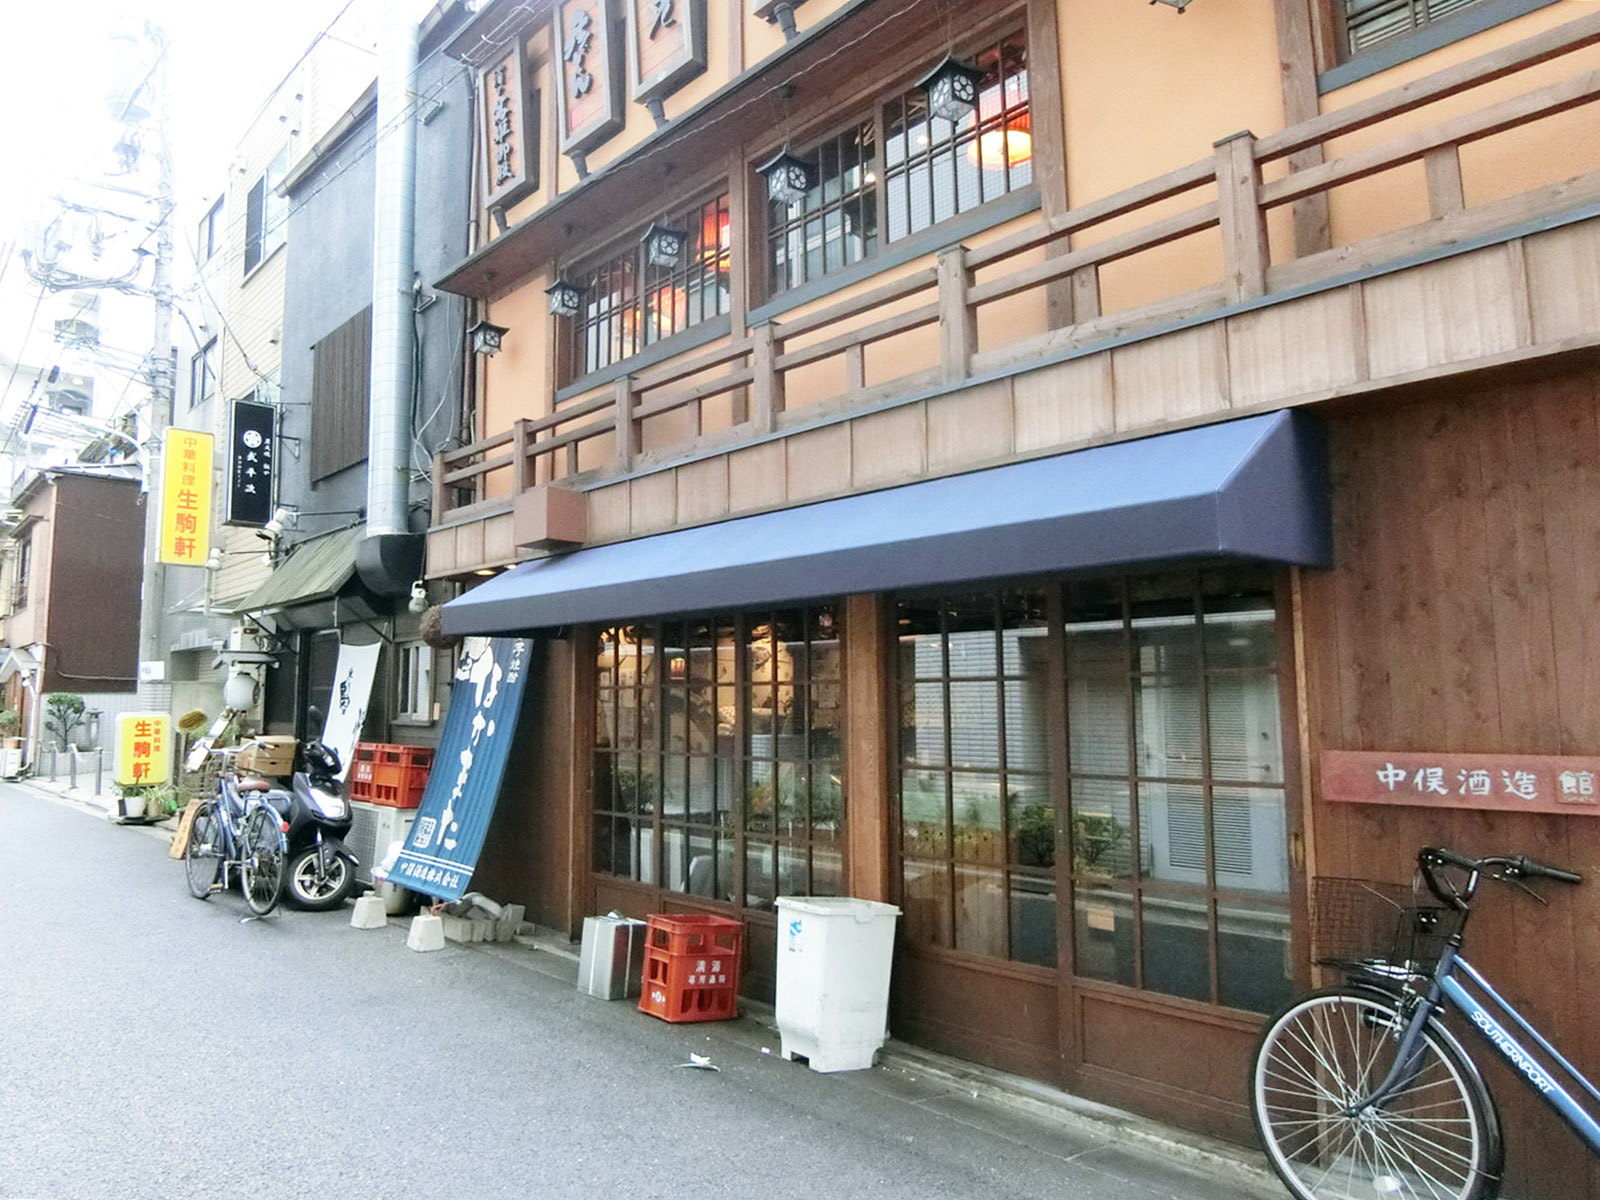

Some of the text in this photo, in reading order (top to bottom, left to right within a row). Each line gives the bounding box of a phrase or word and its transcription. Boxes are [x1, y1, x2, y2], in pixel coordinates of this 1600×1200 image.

[174, 489, 198, 558] 生駒軒
[132, 720, 151, 778] 生駒軒
[1471, 1011, 1555, 1094] SOUTHERNPORT
